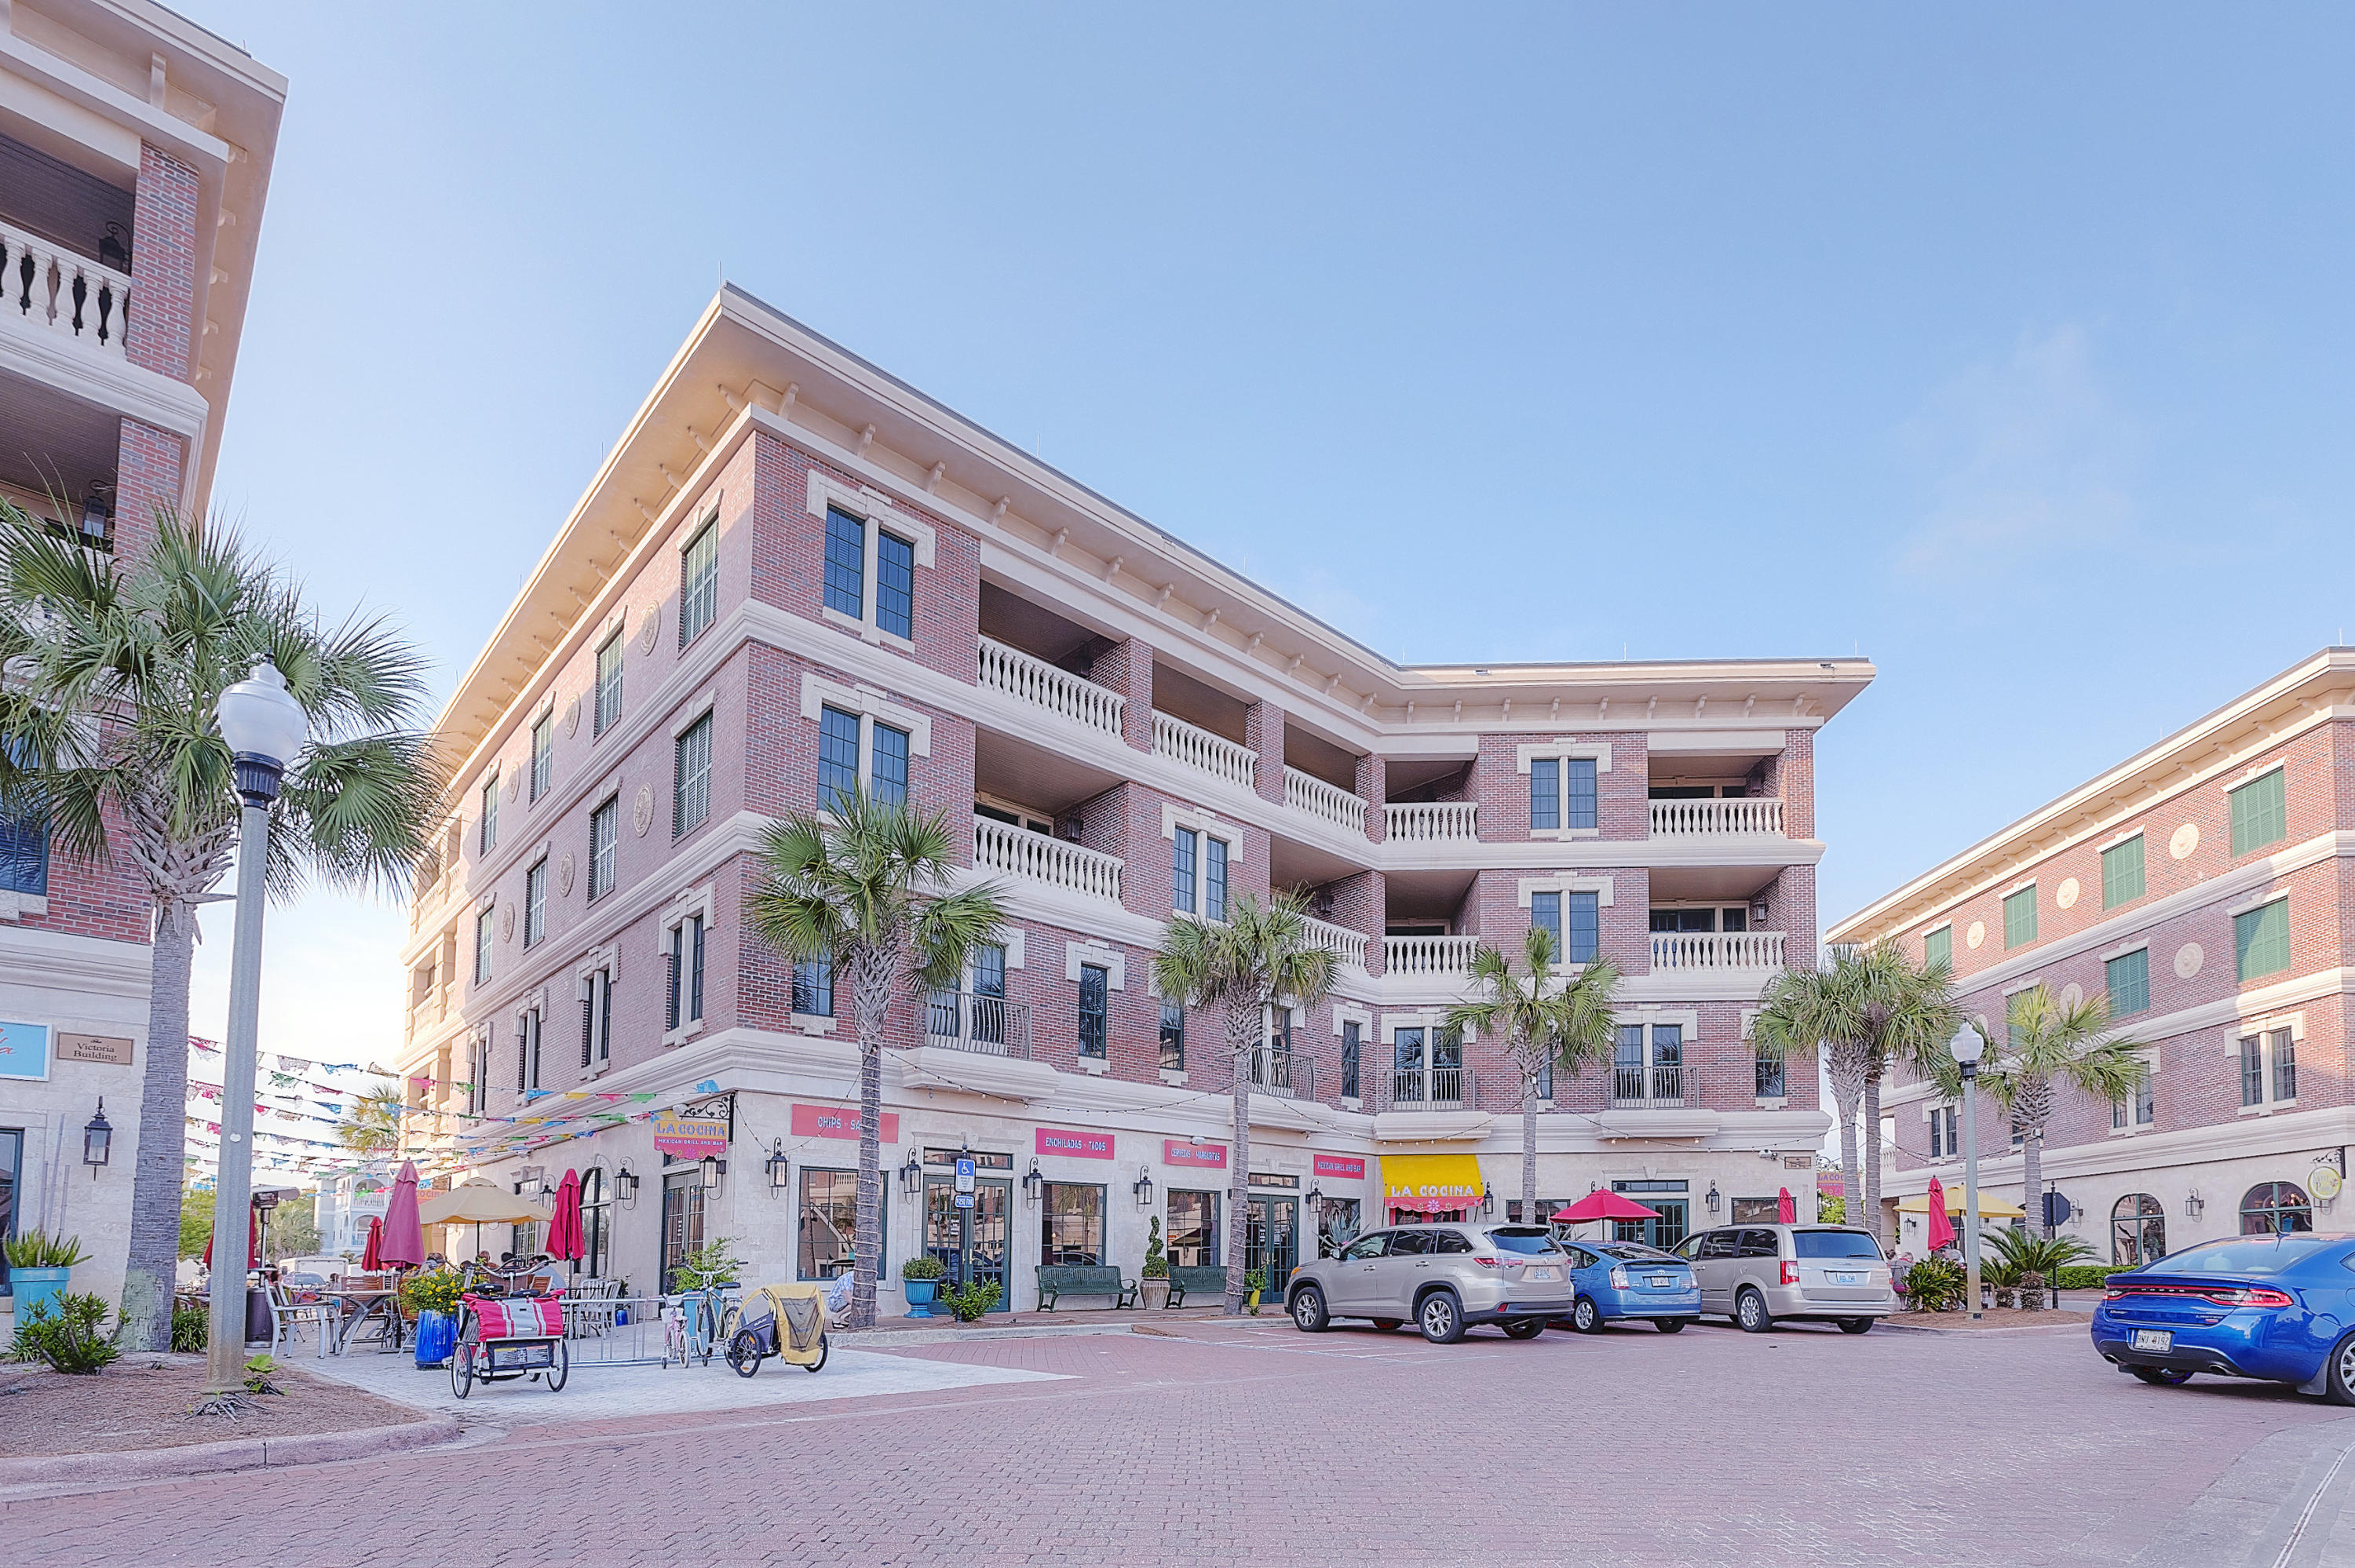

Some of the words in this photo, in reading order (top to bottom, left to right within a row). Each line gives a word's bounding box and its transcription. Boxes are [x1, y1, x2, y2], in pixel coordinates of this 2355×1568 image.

[77, 1043, 115, 1052] Victoria
[74, 1050, 117, 1061] Building
[817, 1116, 842, 1129] CHIPS
[656, 1123, 675, 1134] LA
[678, 1124, 725, 1136] COCINA
[1046, 1137, 1082, 1149] ENCHILADAS
[1088, 1141, 1106, 1151] TACOS
[1391, 1185, 1413, 1197] LA
[1419, 1185, 1474, 1197] COCINA
